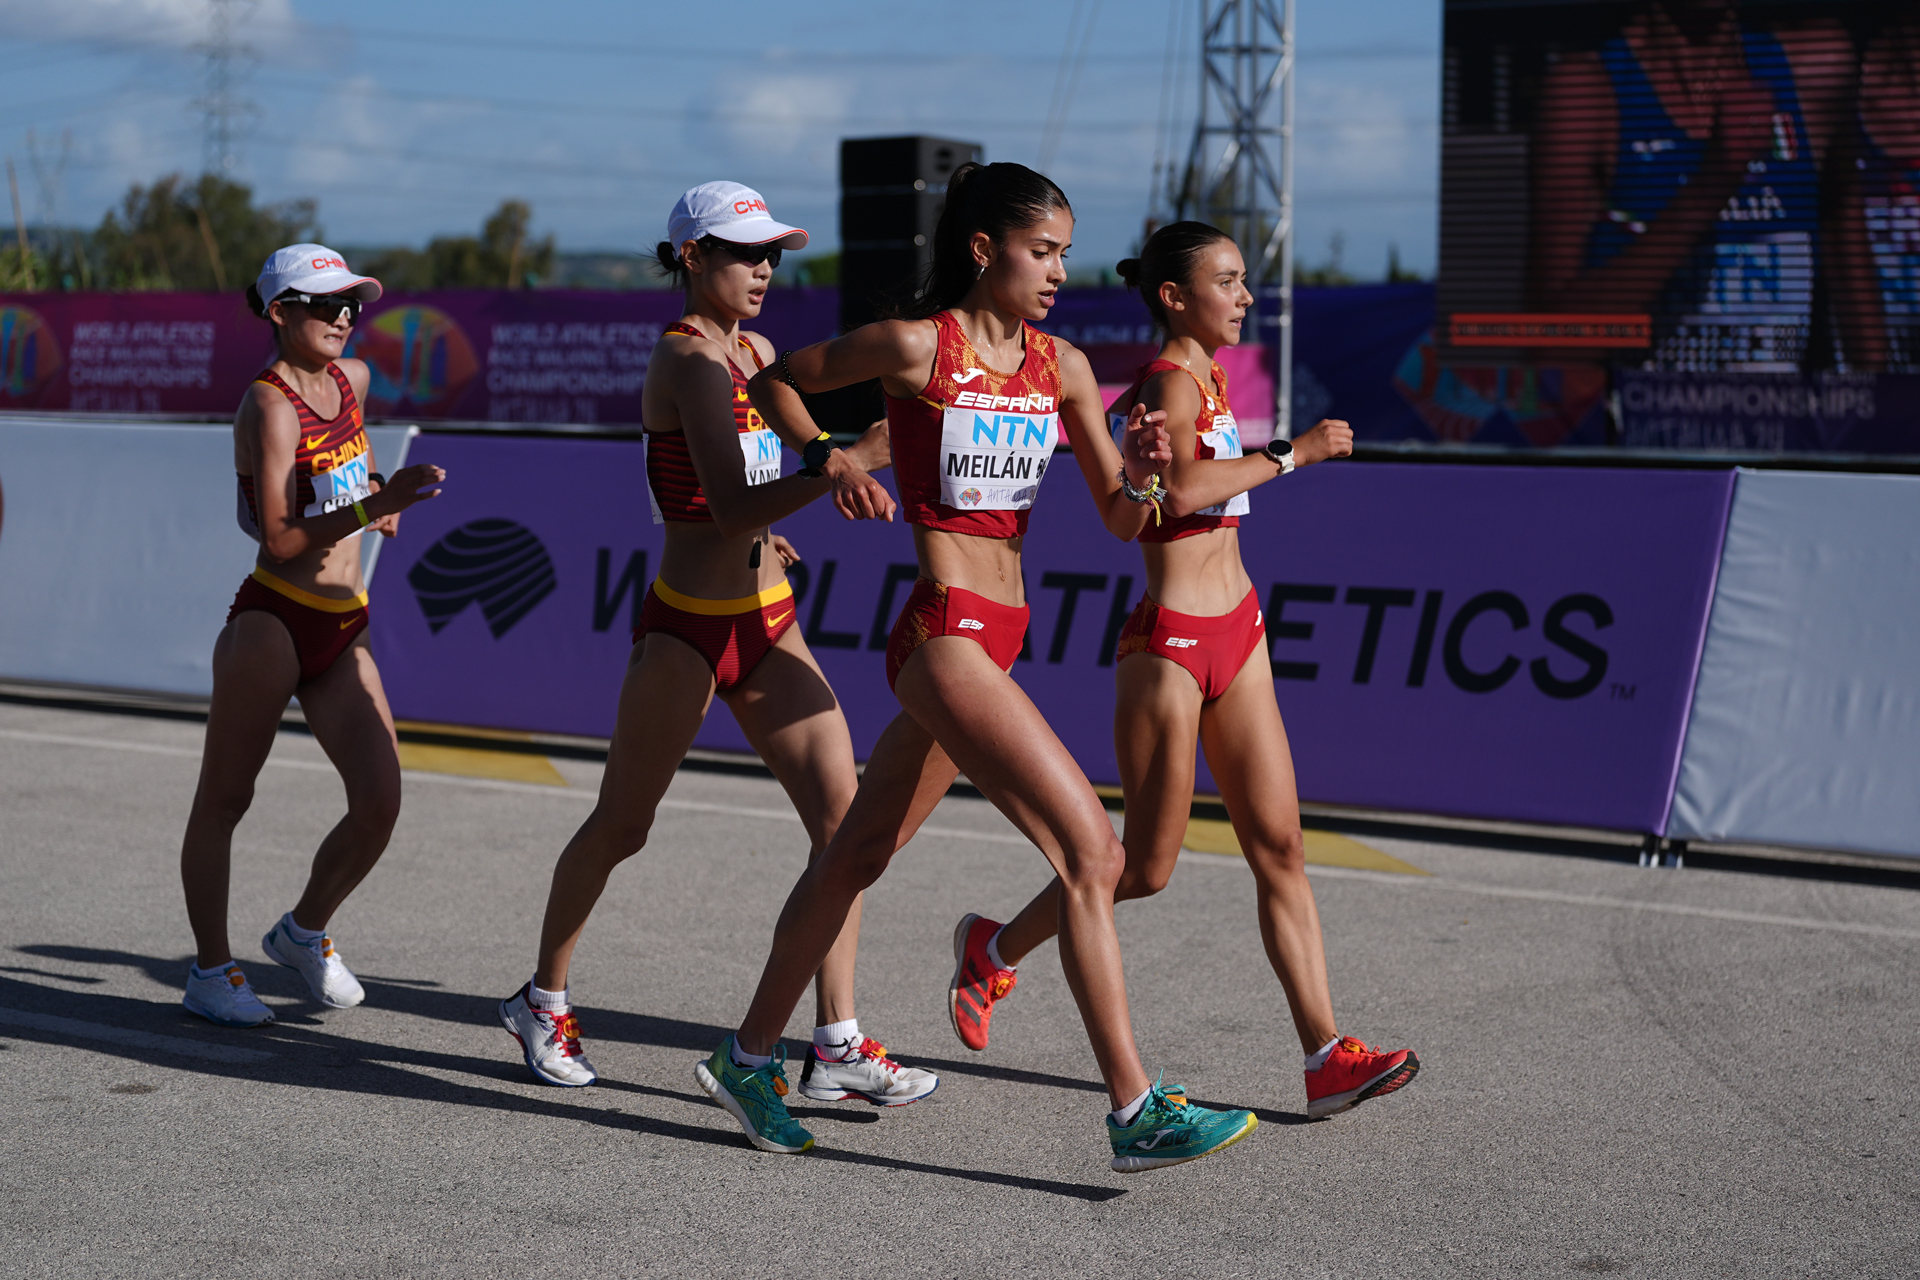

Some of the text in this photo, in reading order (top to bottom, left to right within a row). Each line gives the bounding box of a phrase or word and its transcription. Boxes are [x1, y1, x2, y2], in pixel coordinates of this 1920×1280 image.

[733, 199, 771, 215] CHIN
[312, 258, 351, 273] CHIN
[953, 391, 1055, 412] ESPAÑA
[972, 413, 1049, 449] NTN
[946, 451, 1032, 479] MEILÁN
[1165, 637, 1199, 649] ESP
